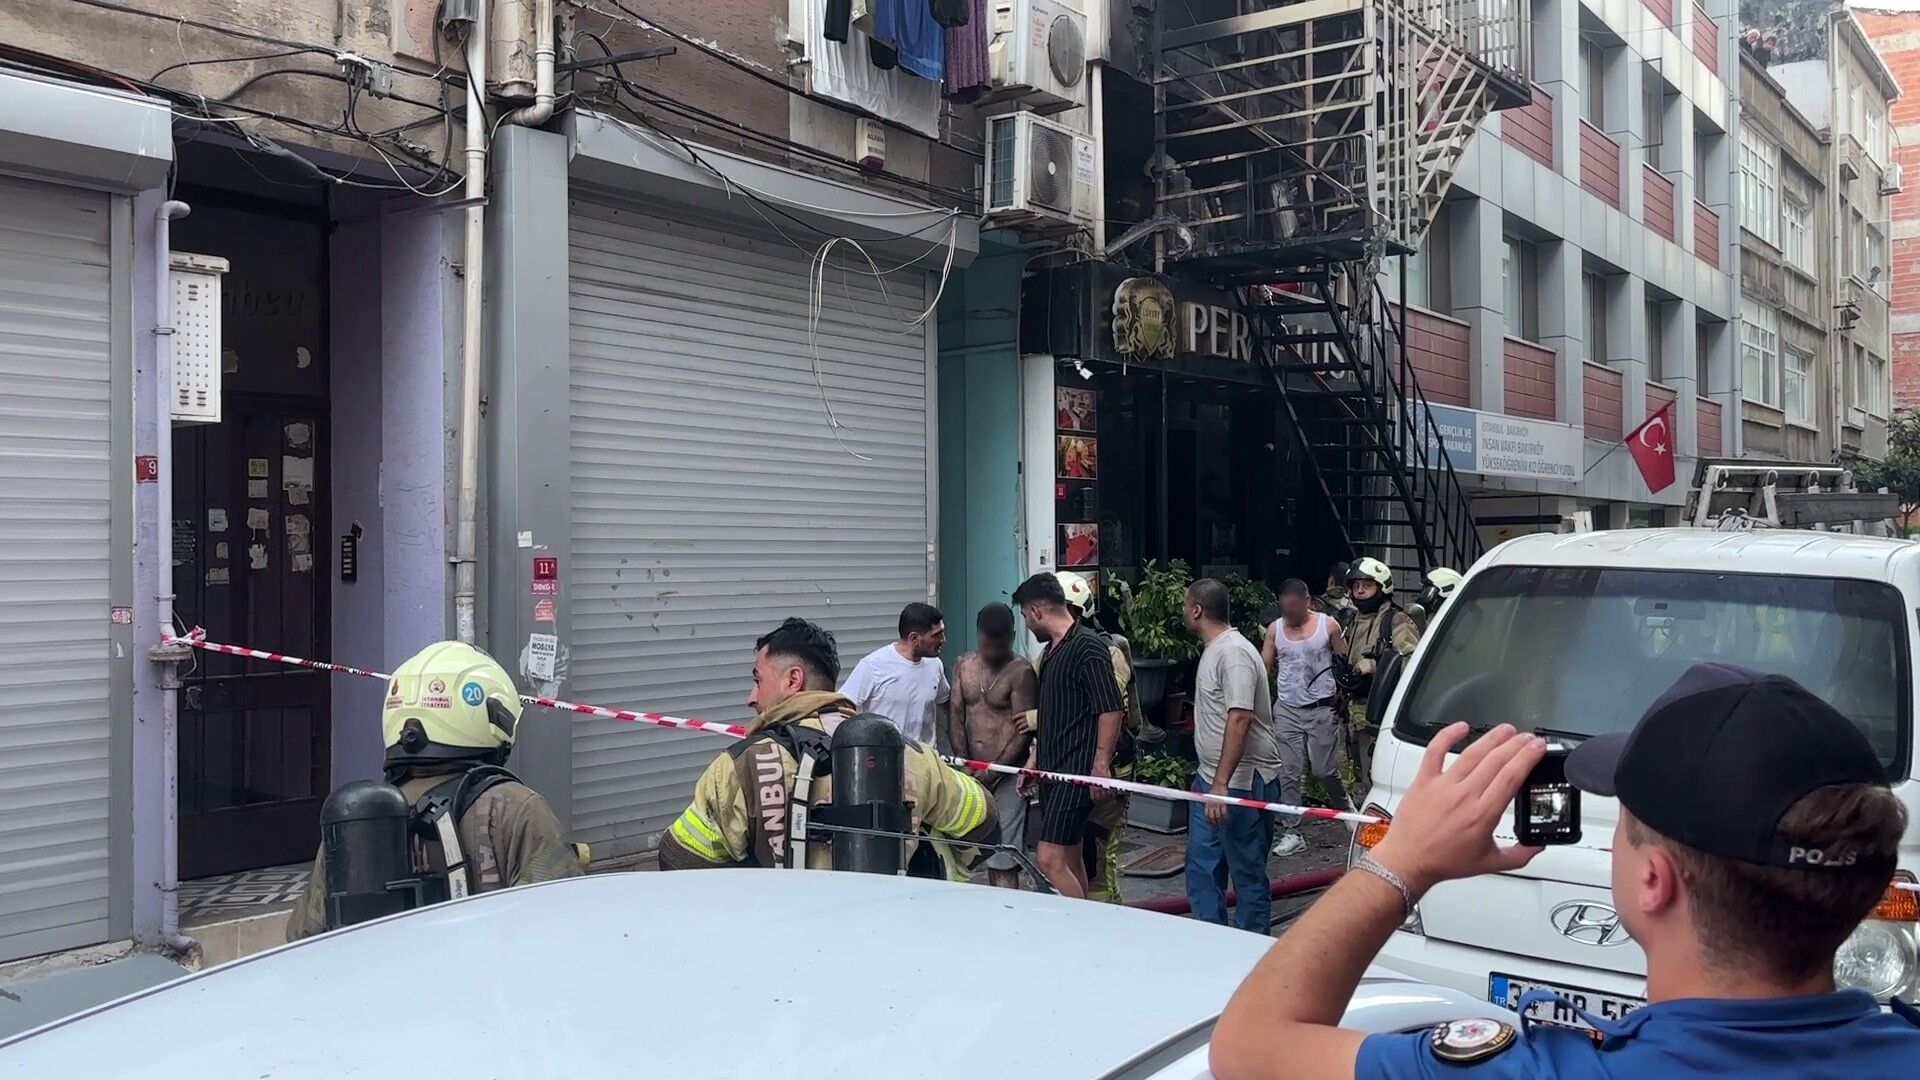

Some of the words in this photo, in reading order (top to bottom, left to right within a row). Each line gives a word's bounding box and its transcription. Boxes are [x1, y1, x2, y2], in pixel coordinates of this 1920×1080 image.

[1188, 302, 1253, 363] PER
[148, 460, 157, 475] 9
[464, 686, 481, 702] 20
[1494, 996, 1506, 1006] TR
